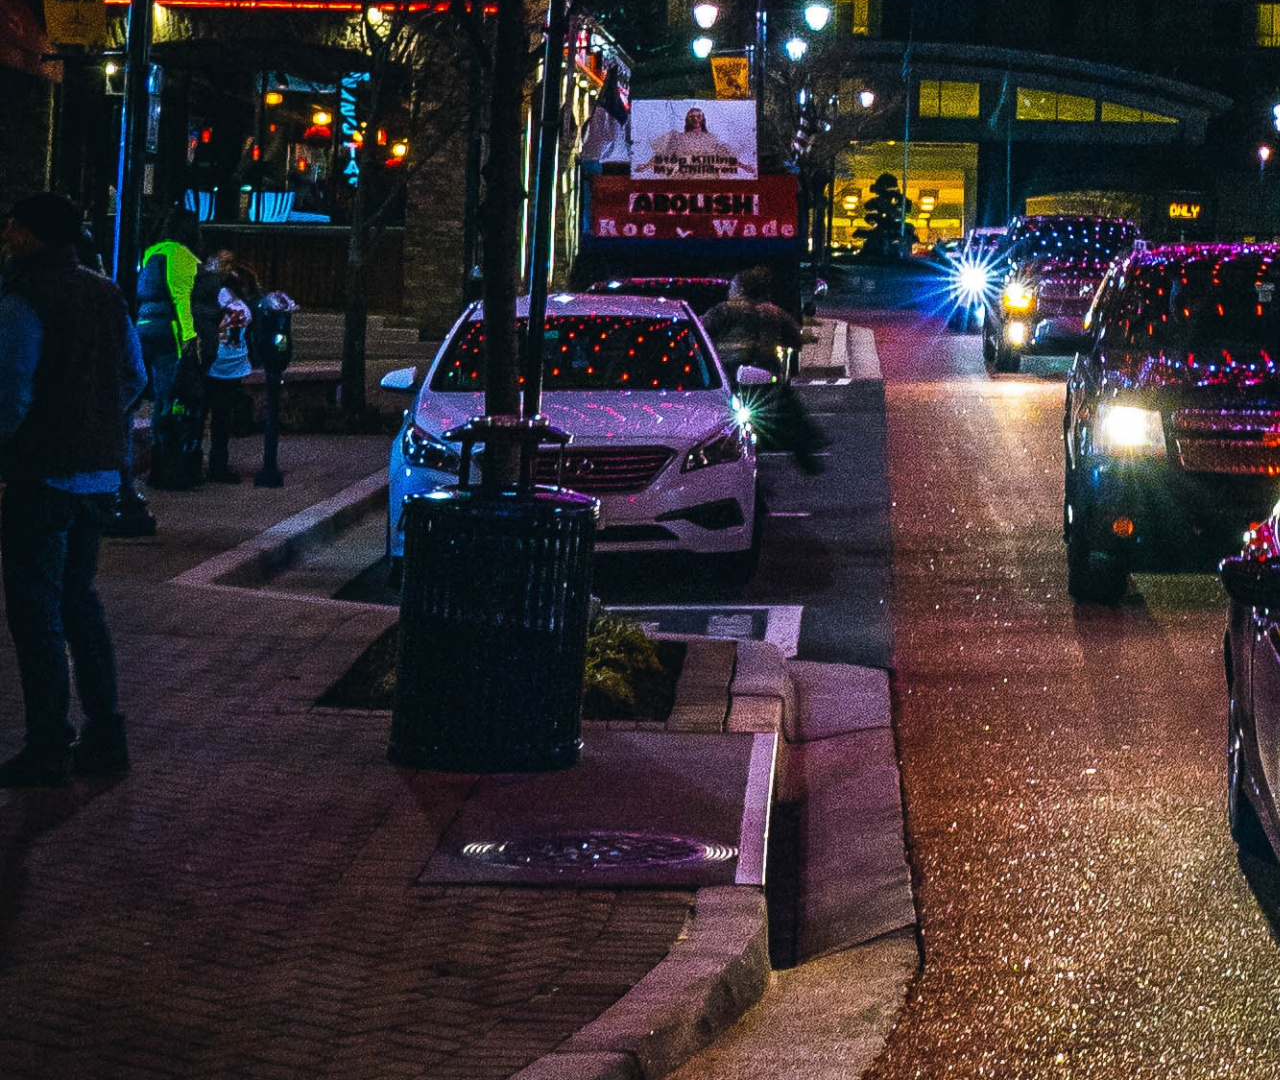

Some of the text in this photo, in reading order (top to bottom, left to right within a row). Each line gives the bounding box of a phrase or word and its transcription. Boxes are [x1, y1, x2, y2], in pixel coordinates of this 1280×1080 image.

[632, 193, 754, 214] ABOLISH
[597, 219, 657, 237] Roe
[712, 219, 796, 237] Wade
